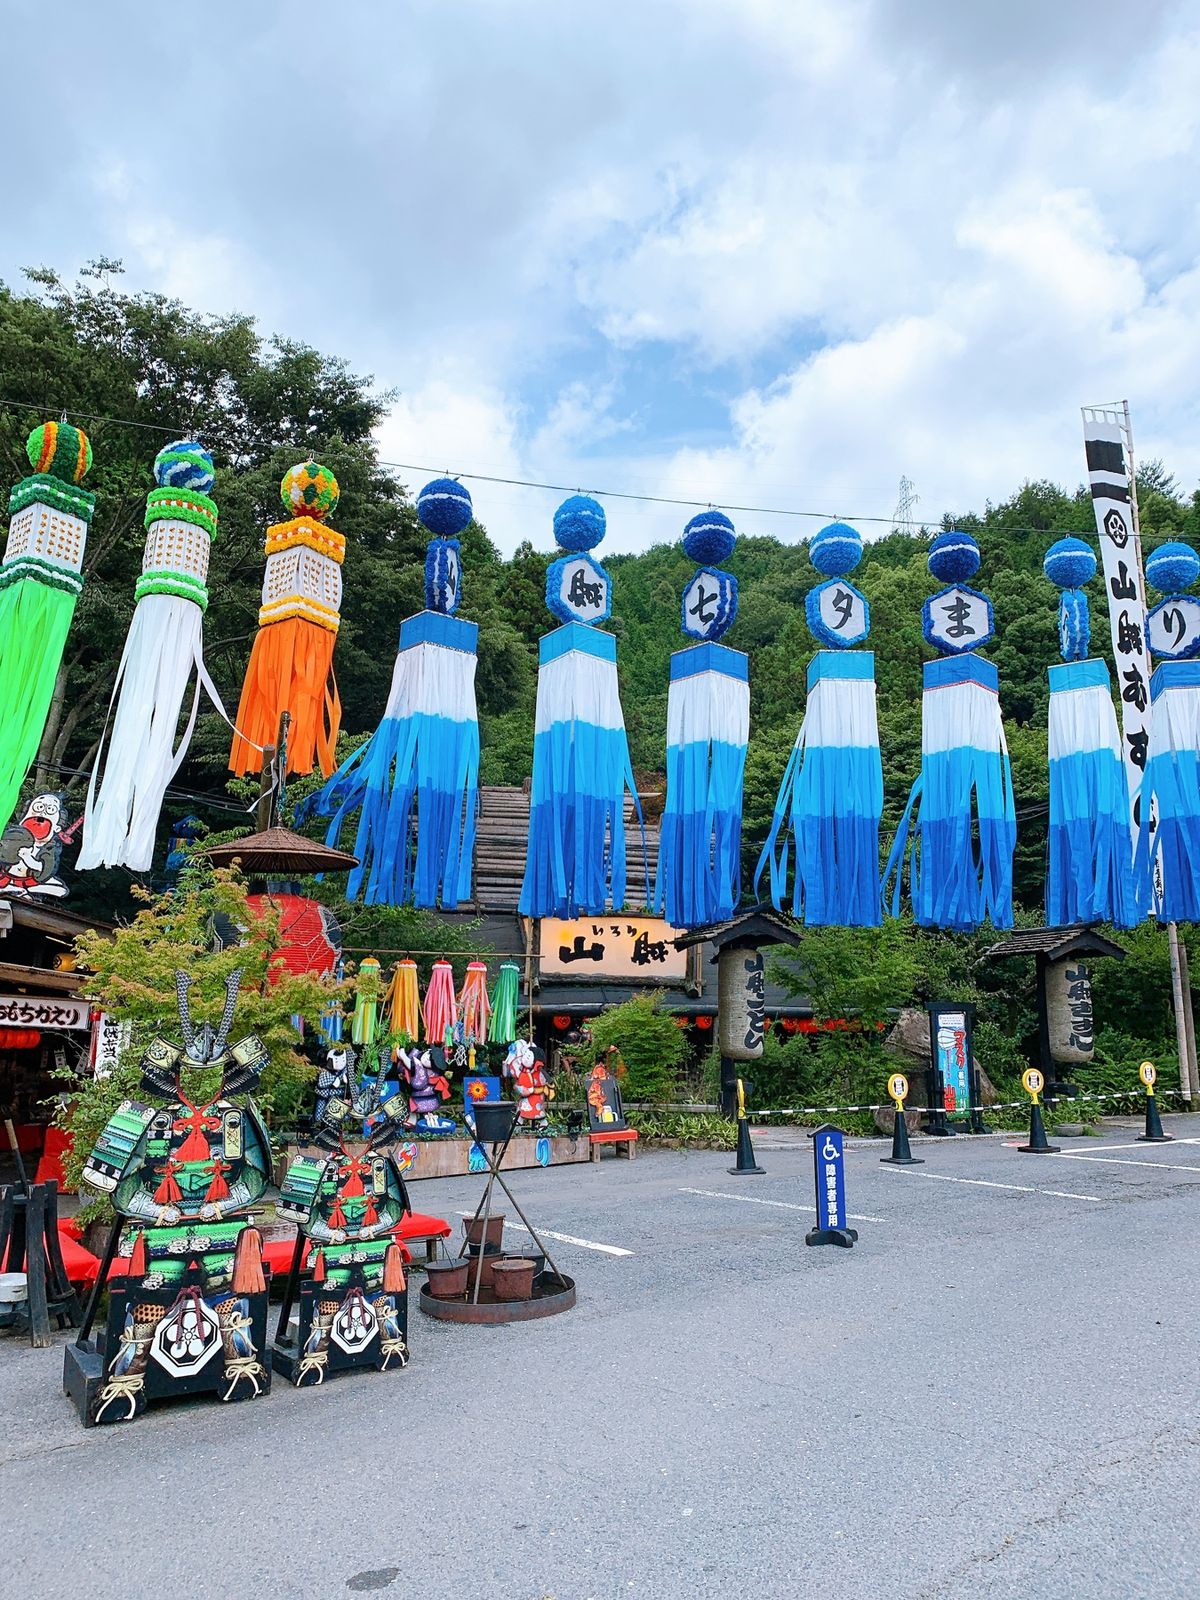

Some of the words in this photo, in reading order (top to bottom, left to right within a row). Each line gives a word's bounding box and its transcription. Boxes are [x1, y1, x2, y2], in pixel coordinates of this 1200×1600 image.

[688, 584, 718, 626] 七
[940, 596, 975, 639] ま
[1162, 607, 1187, 650] り
[558, 931, 669, 966] 山賊
[591, 924, 638, 938] いろり
[825, 1163, 839, 1228] 障害者専用
